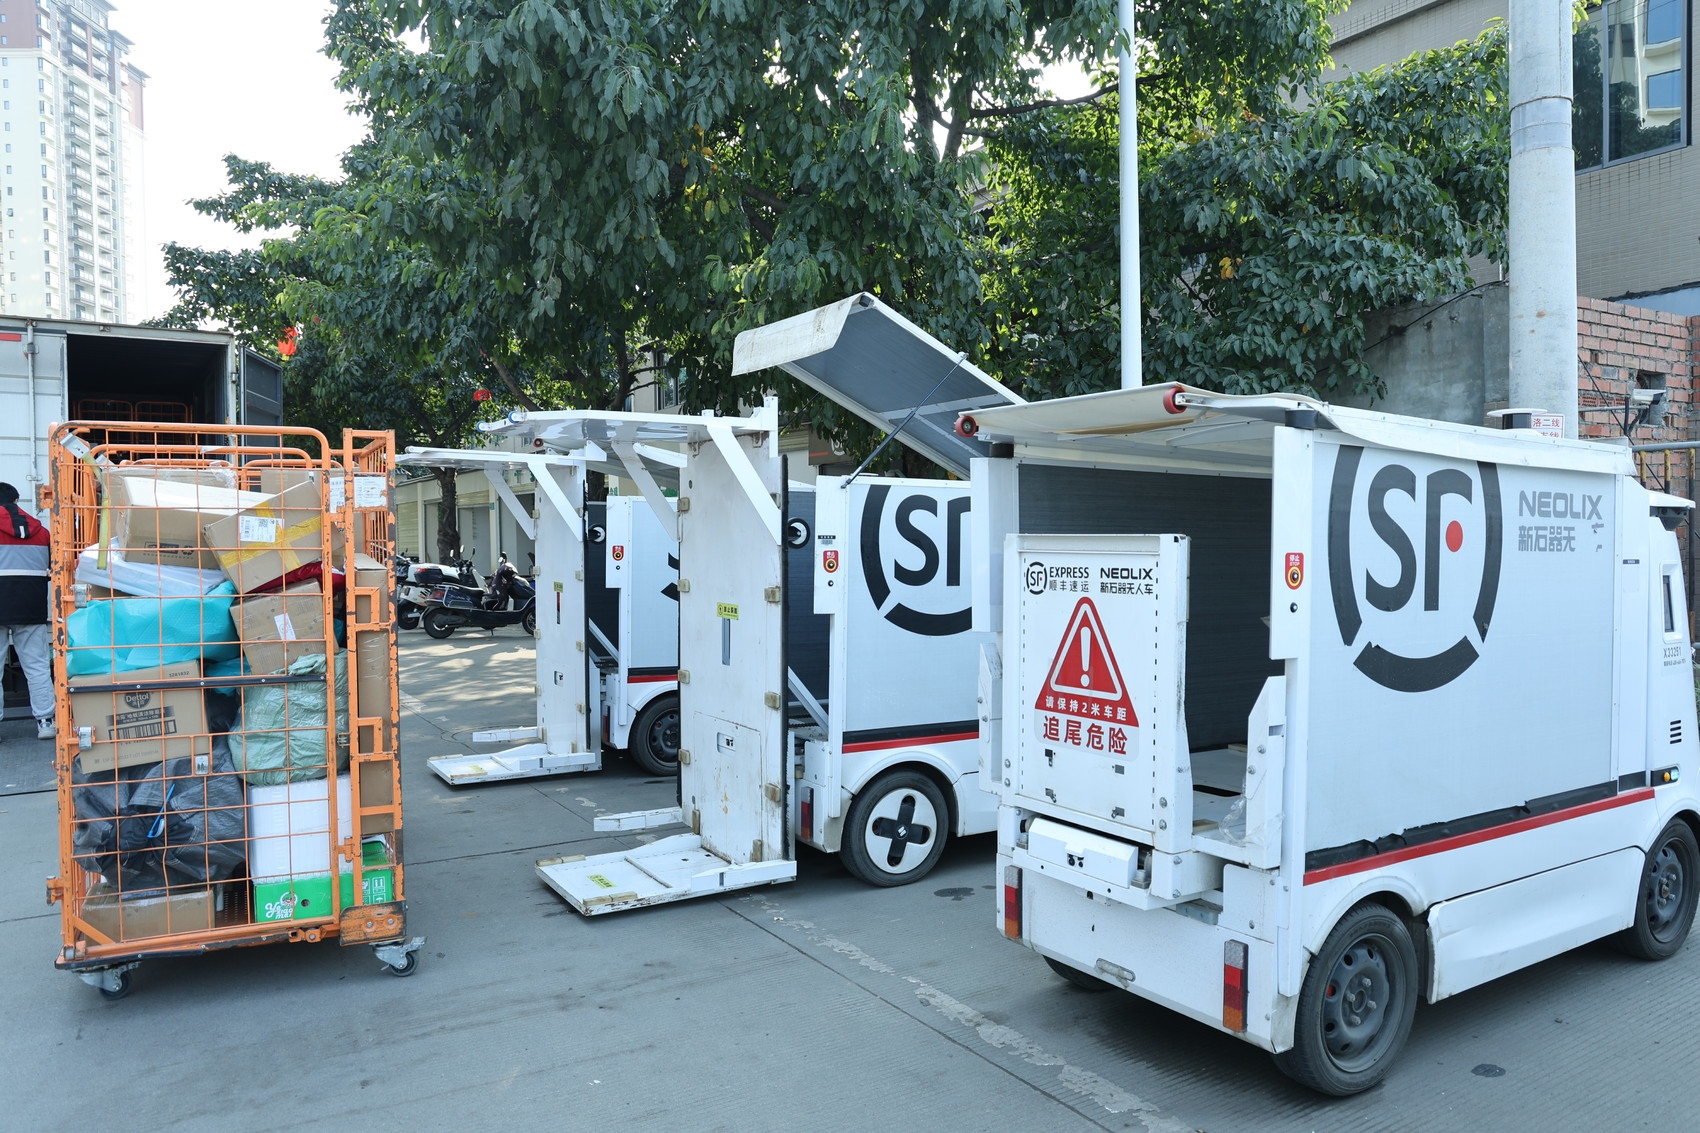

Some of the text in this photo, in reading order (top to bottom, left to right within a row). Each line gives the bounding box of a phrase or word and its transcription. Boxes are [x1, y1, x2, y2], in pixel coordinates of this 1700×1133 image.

[1519, 490, 1602, 520] NEOLIX
[1049, 566, 1089, 579] EXPRESS
[1100, 567, 1153, 580] NEOLIX
[1049, 580, 1089, 592] 顺丰速运
[1100, 582, 1153, 595] 新石器无人车
[125, 692, 150, 703] Dettol
[1045, 696, 1127, 721] 请保持2米车距
[1043, 715, 1128, 755] 追尾危险
